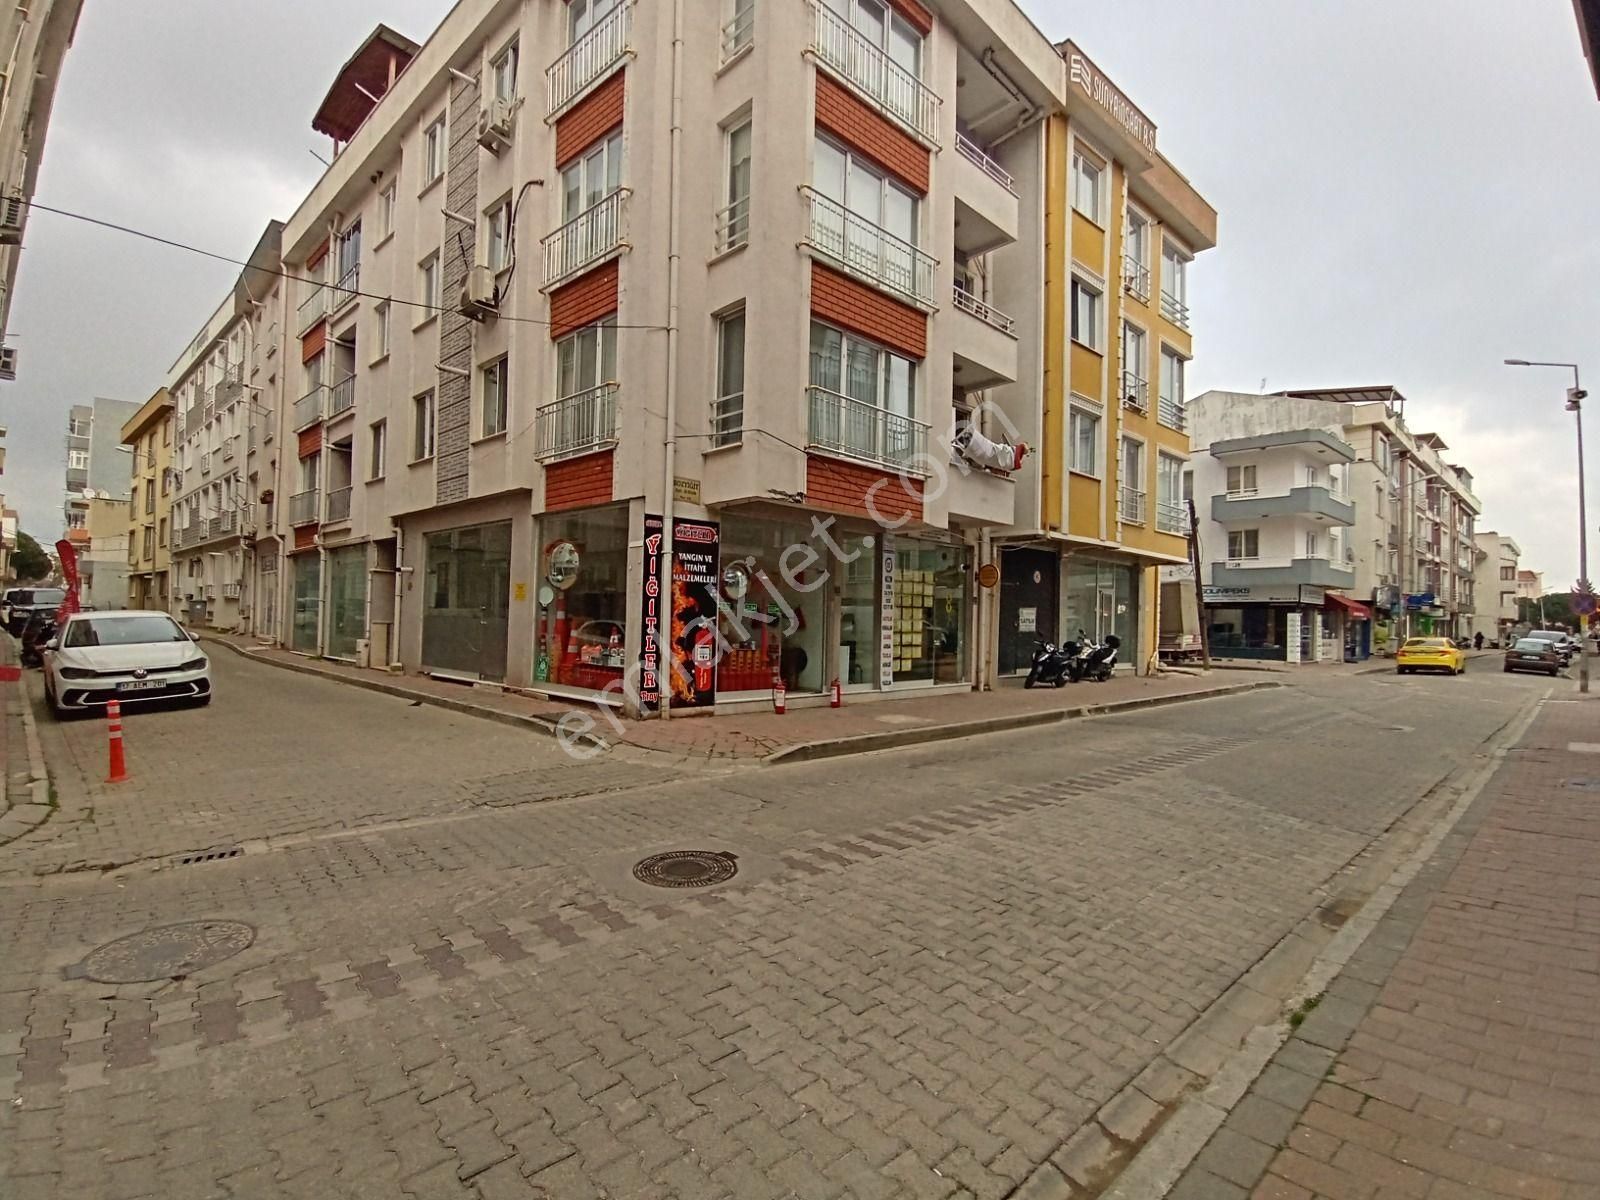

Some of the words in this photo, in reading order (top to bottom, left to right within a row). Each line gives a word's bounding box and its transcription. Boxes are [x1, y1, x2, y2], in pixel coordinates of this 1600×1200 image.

[678, 552, 703, 562] YANGIN
[704, 555, 713, 563] VE
[684, 562, 707, 573] İTFAİYE
